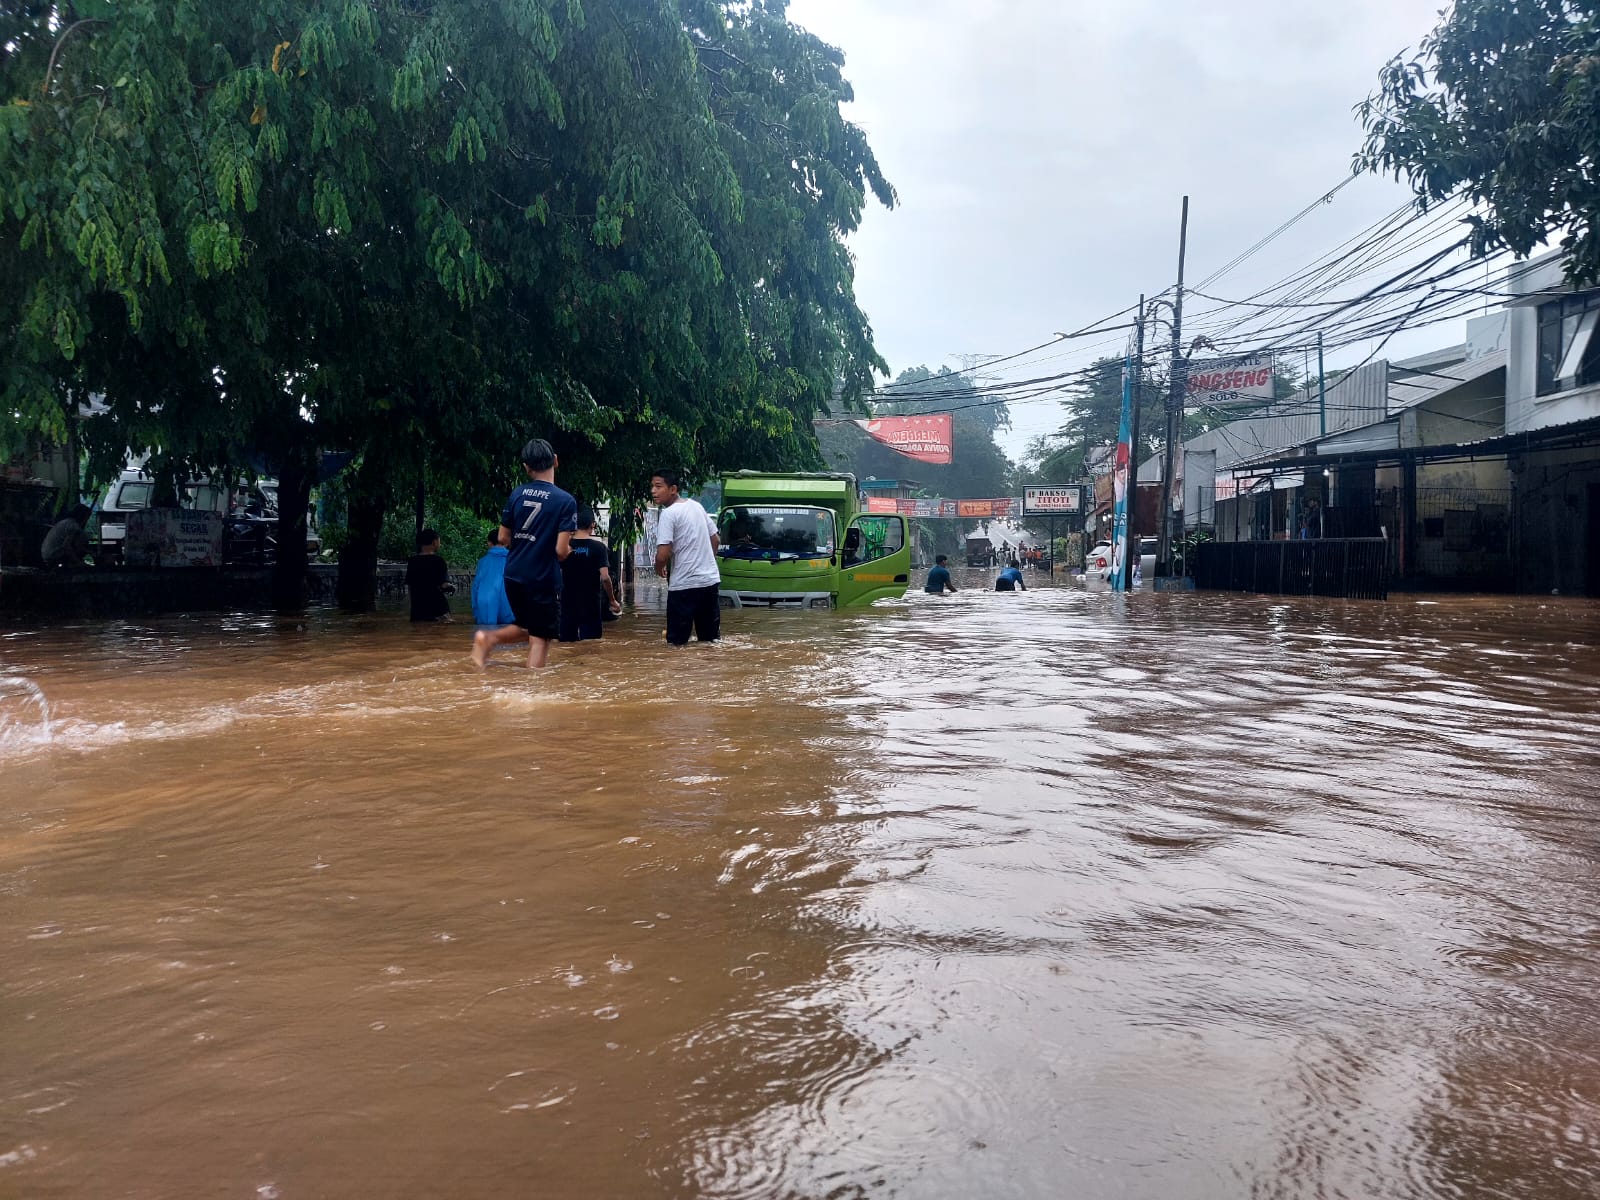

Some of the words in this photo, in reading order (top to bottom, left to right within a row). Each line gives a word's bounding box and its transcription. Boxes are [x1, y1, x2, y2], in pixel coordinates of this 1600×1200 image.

[1187, 367, 1269, 393] ONGSENG
[1209, 391, 1238, 402] SOLO
[1037, 496, 1070, 504] TITOTI
[521, 500, 542, 530] 7
